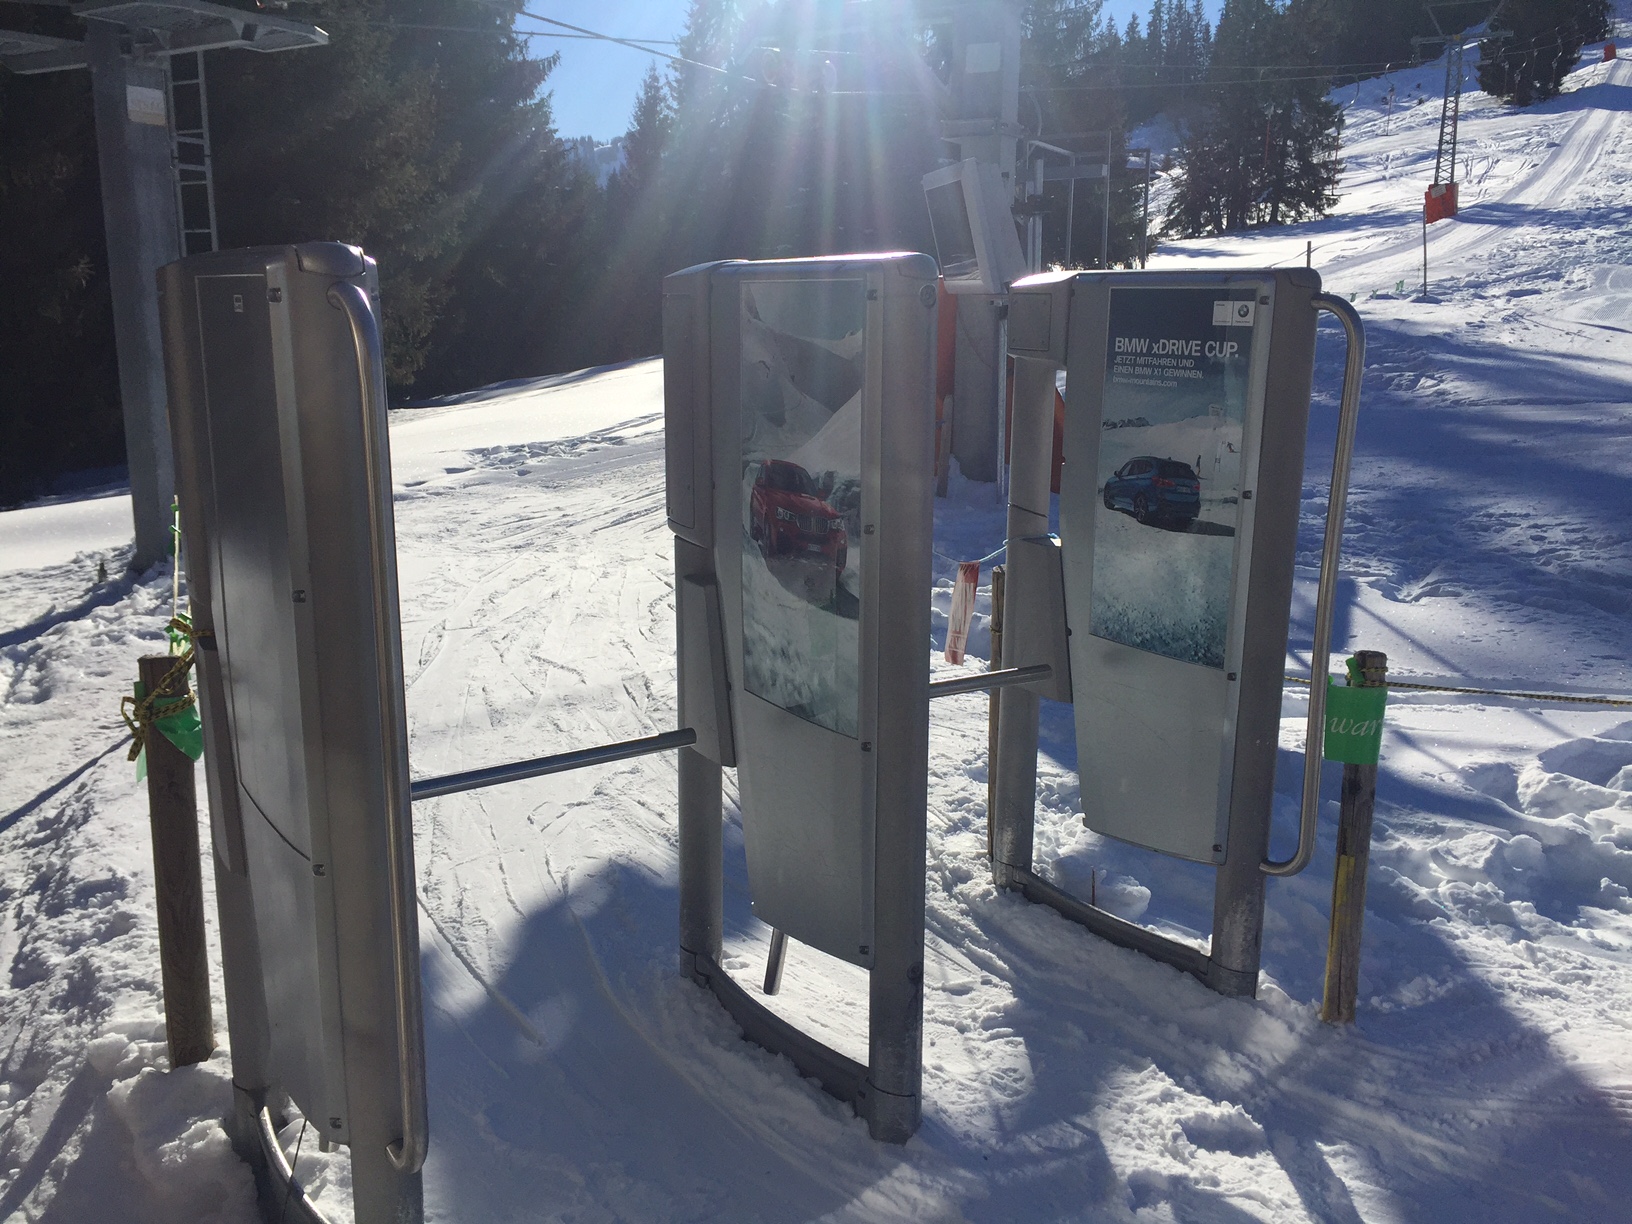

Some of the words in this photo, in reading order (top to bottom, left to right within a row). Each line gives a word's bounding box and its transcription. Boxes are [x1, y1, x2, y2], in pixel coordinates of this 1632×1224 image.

[1115, 337, 1149, 353] BMW
[1151, 339, 1202, 356] xDRIVE
[1205, 341, 1239, 358] CUP.
[1114, 356, 1136, 365] JETZT
[1136, 357, 1178, 367] MITFAHREN
[1178, 359, 1195, 368] UND
[1113, 365, 1134, 374] EINEN
[1134, 366, 1153, 375] BMW
[1153, 367, 1162, 376] X1
[1163, 368, 1204, 379] GEWINNEN.
[1112, 375, 1178, 388] bmw-mountains.com
